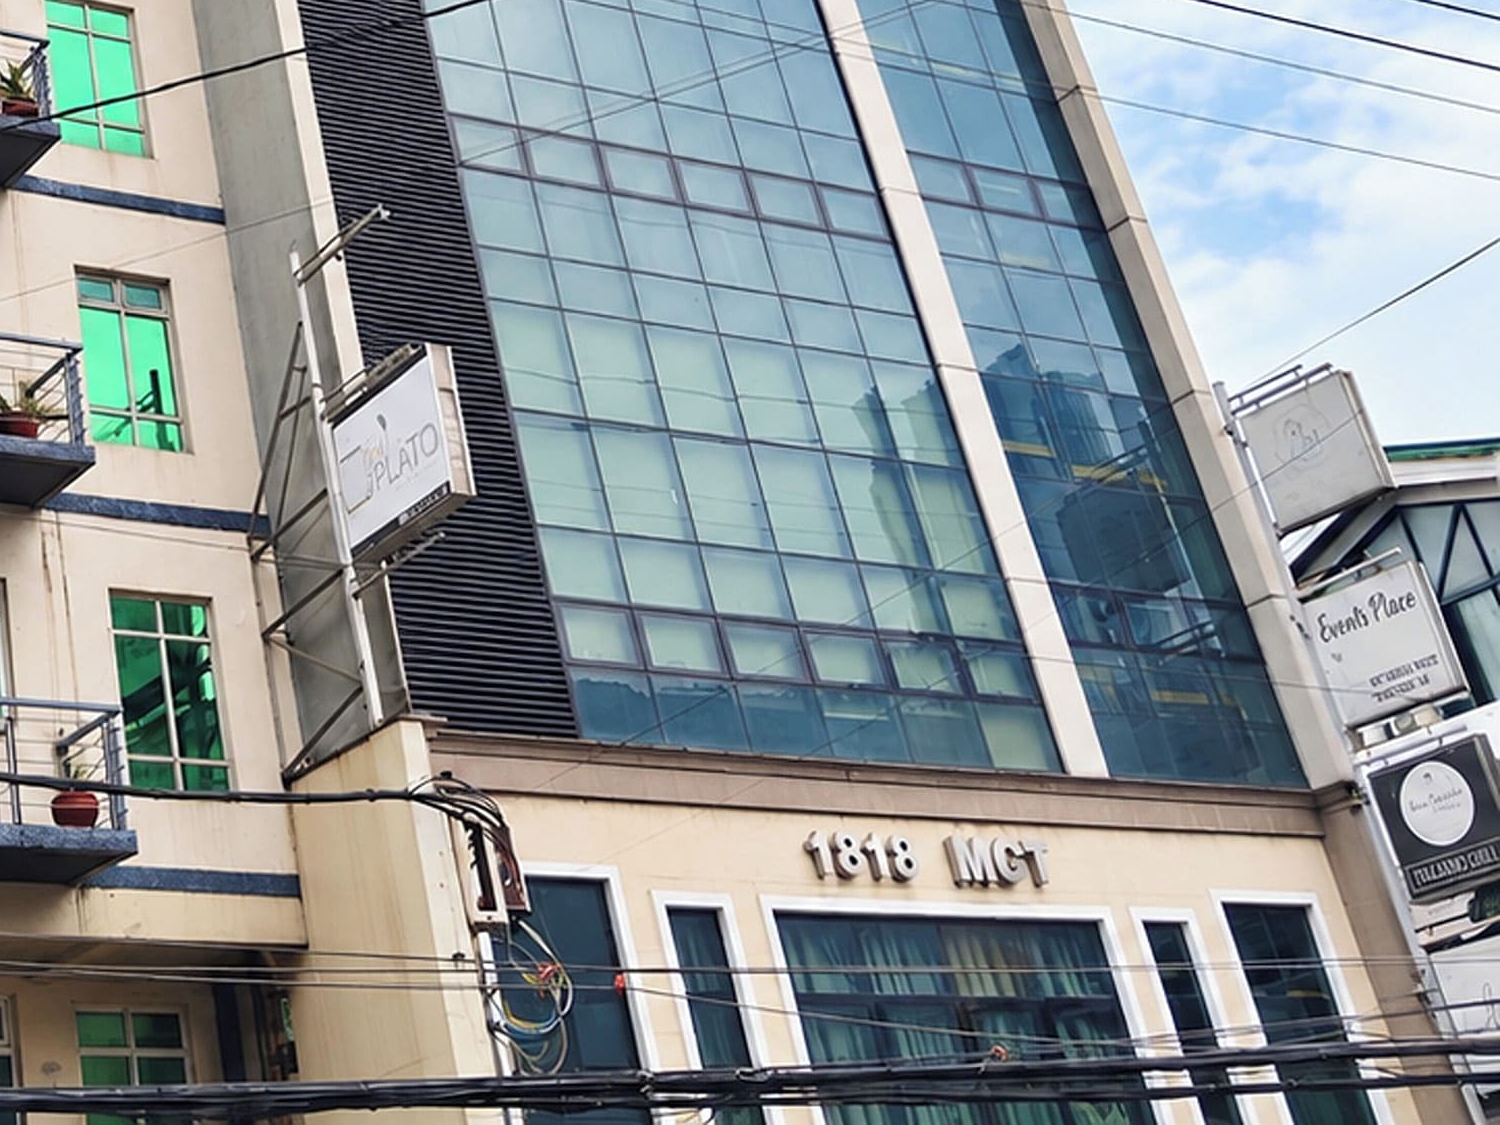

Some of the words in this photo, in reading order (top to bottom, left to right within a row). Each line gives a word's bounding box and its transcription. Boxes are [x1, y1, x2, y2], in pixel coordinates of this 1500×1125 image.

[1317, 606, 1369, 643] Events
[1368, 592, 1416, 622] Place
[804, 830, 918, 883] 1818
